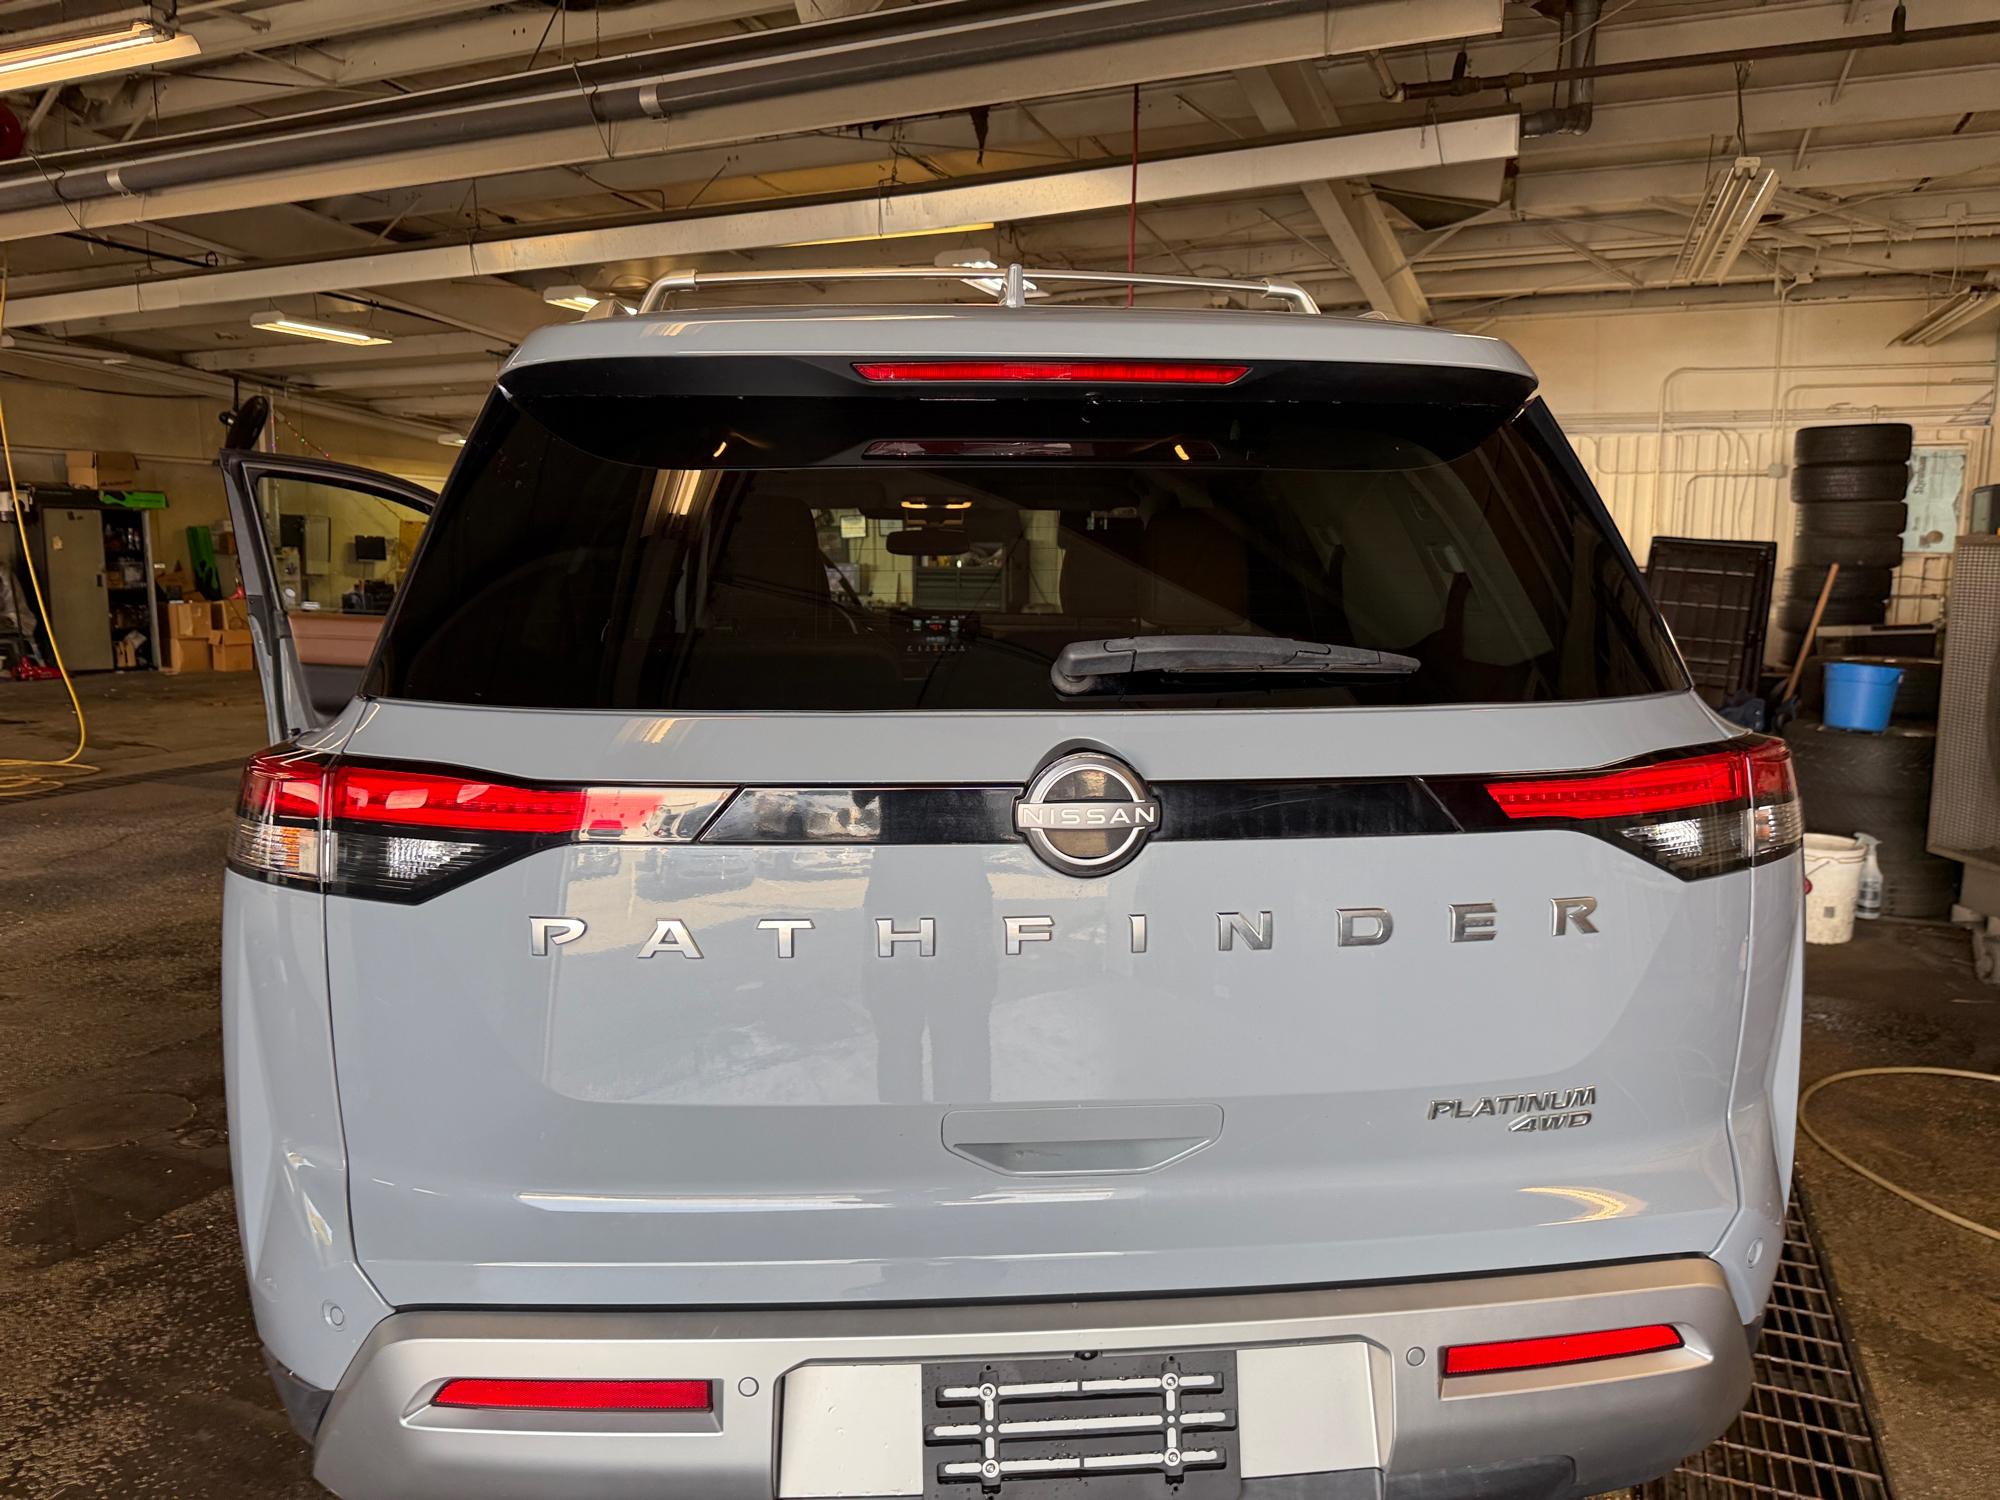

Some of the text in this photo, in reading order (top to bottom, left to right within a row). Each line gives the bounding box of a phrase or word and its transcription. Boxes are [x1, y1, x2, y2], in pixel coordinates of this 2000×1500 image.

[1022, 806, 1155, 825] NISSAN
[528, 896, 1600, 960] PATHFINDER
[1427, 1085, 1597, 1121] PLATINUM
[1508, 1110, 1592, 1132] 4WD
